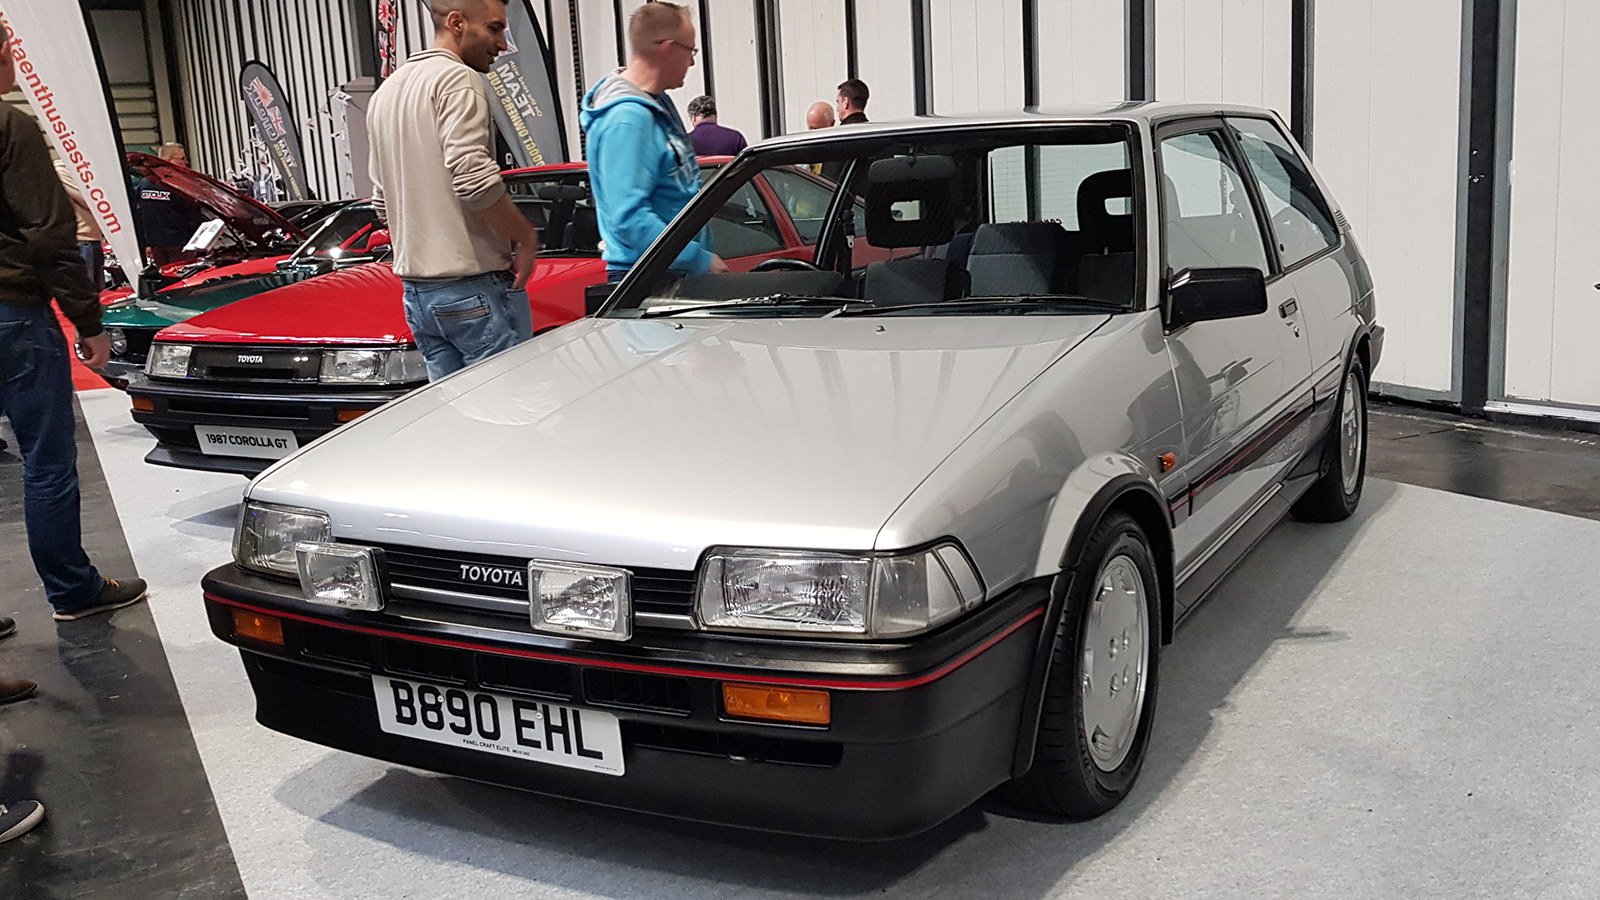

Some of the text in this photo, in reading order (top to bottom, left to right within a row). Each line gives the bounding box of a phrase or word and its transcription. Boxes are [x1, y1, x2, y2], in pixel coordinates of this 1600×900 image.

[238, 355, 263, 363] TOYOTA
[206, 433, 288, 449] 1987 COROLLA GT
[460, 564, 523, 586] TOYOTA
[389, 679, 603, 760] B890 EHL
[462, 739, 479, 747] PANEL
[479, 741, 496, 749] CRAFT
